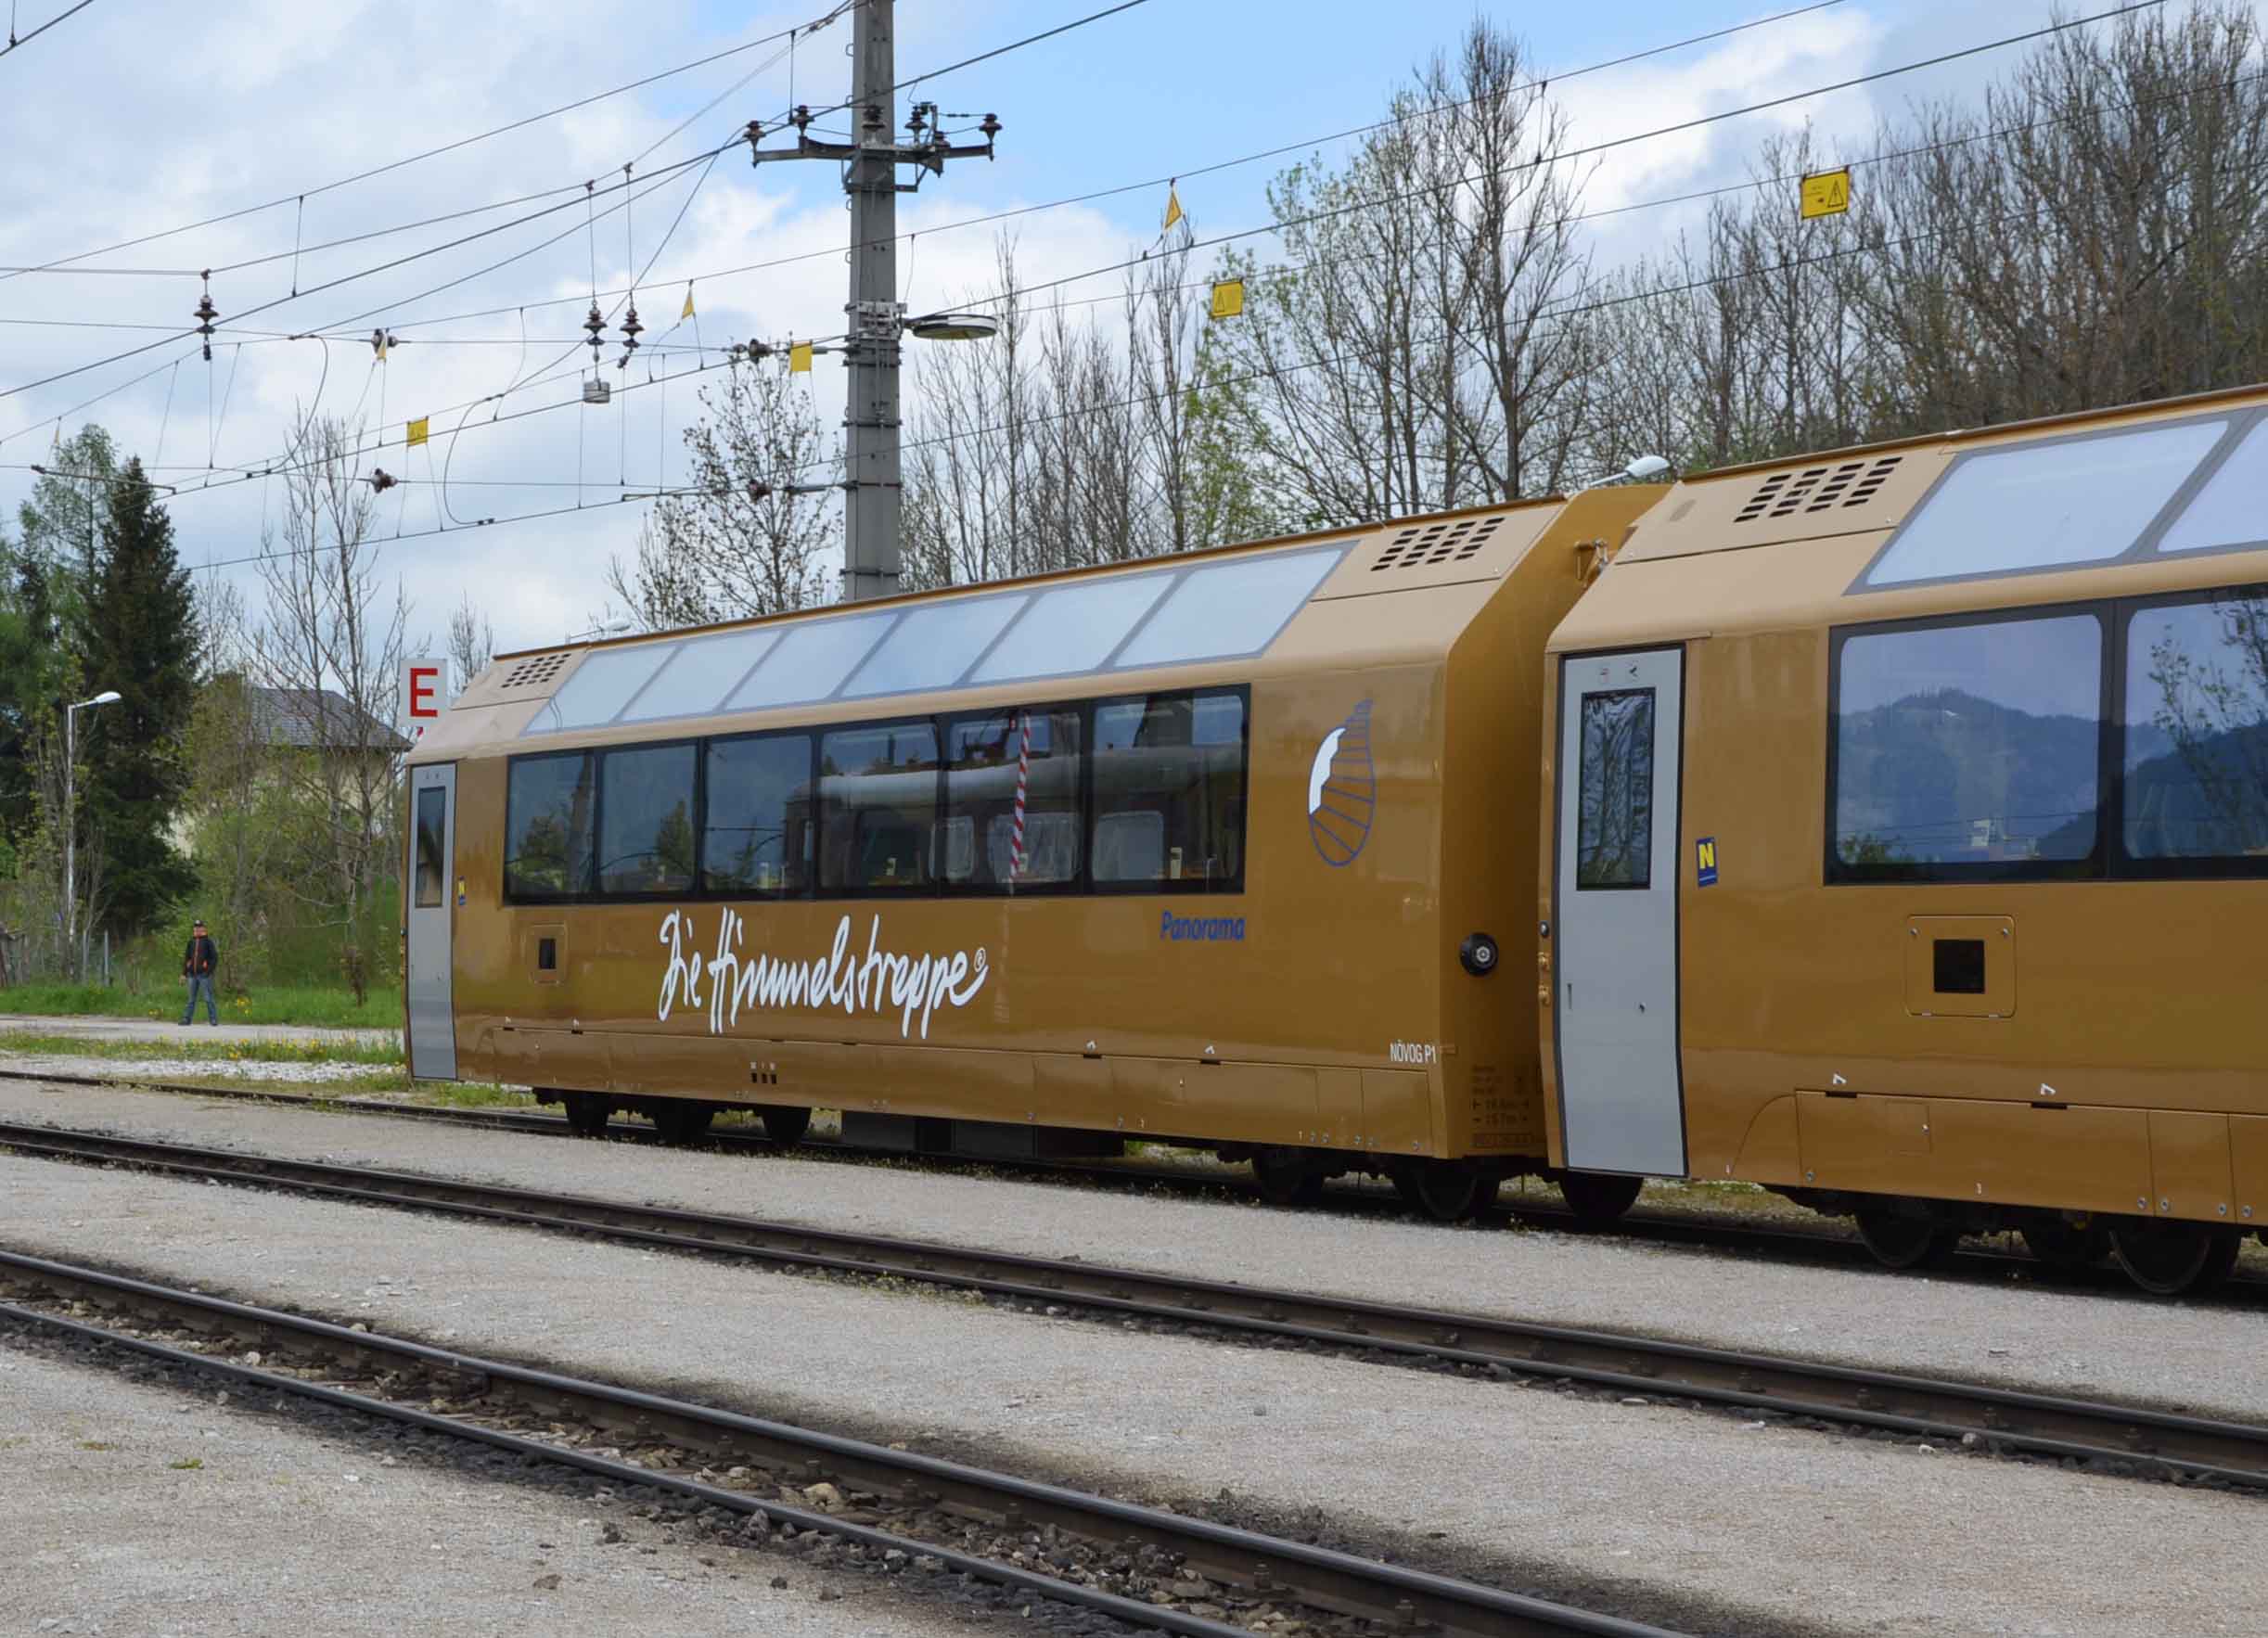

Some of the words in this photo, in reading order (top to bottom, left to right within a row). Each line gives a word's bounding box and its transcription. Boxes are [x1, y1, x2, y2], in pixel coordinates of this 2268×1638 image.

[409, 667, 439, 718] E
[1698, 842, 1715, 870] N
[1160, 910, 1246, 941] Panorama
[660, 908, 702, 1021] Die
[1390, 1039, 1424, 1064] NÖVOG
